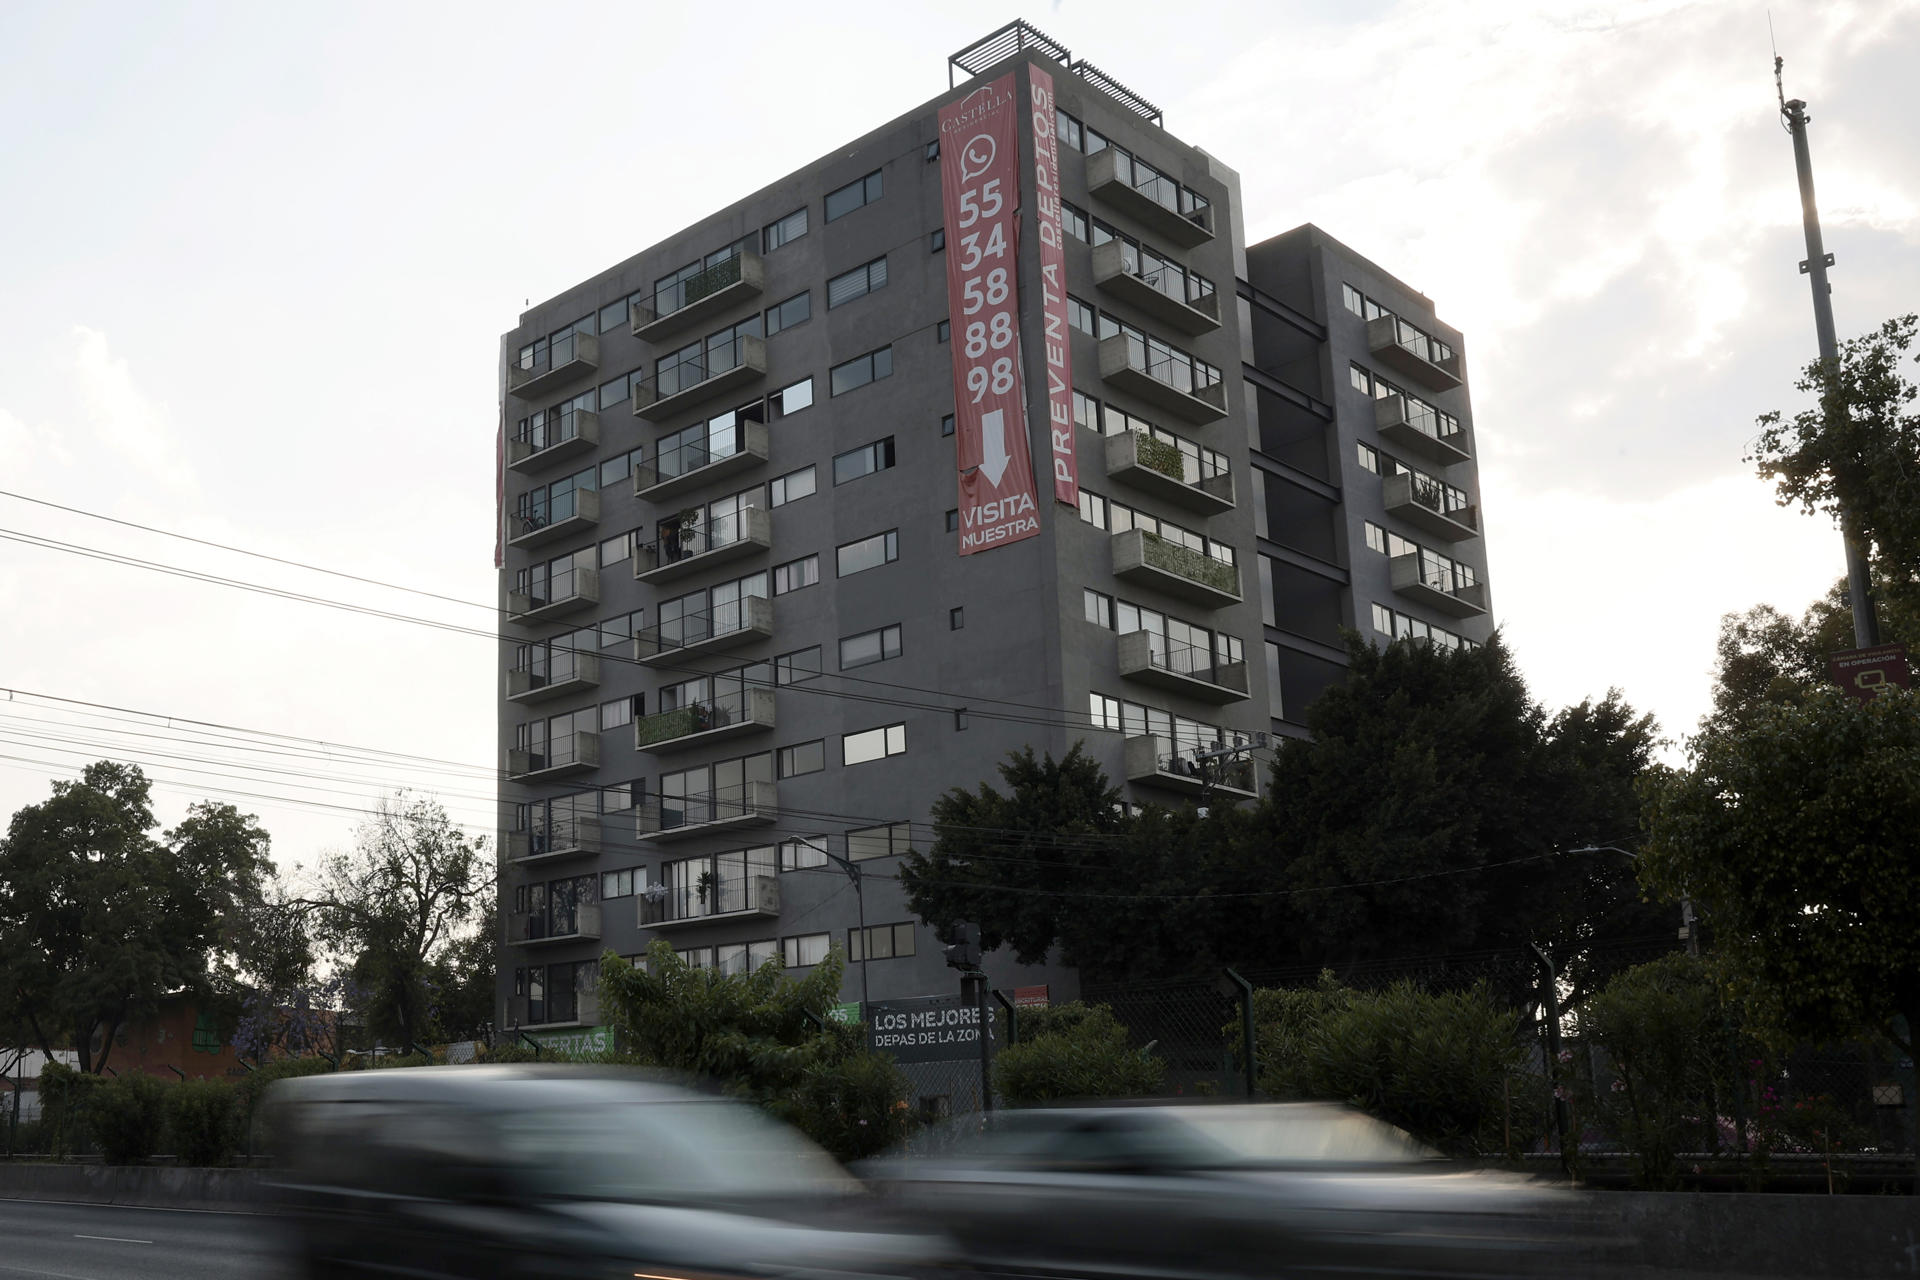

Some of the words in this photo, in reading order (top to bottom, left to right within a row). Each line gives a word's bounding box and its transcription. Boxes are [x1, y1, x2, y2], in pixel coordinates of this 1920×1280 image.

[941, 90, 1013, 134] CASTELLA
[1033, 84, 1056, 248] DEPTOS
[959, 178, 1003, 229] 55
[960, 222, 1007, 272] 34
[963, 267, 1009, 316] 58
[964, 311, 1013, 359] 88
[966, 356, 1014, 404] 98
[1042, 263, 1074, 483] PREVENTA
[962, 492, 1035, 529] VISITA
[962, 517, 1038, 549] MUESTRA
[875, 1012, 907, 1031] LOS
[910, 1006, 996, 1029] MEJORES
[875, 1032, 916, 1048] DEPAS
[918, 1031, 936, 1045] DE
[938, 1030, 955, 1044] LA
